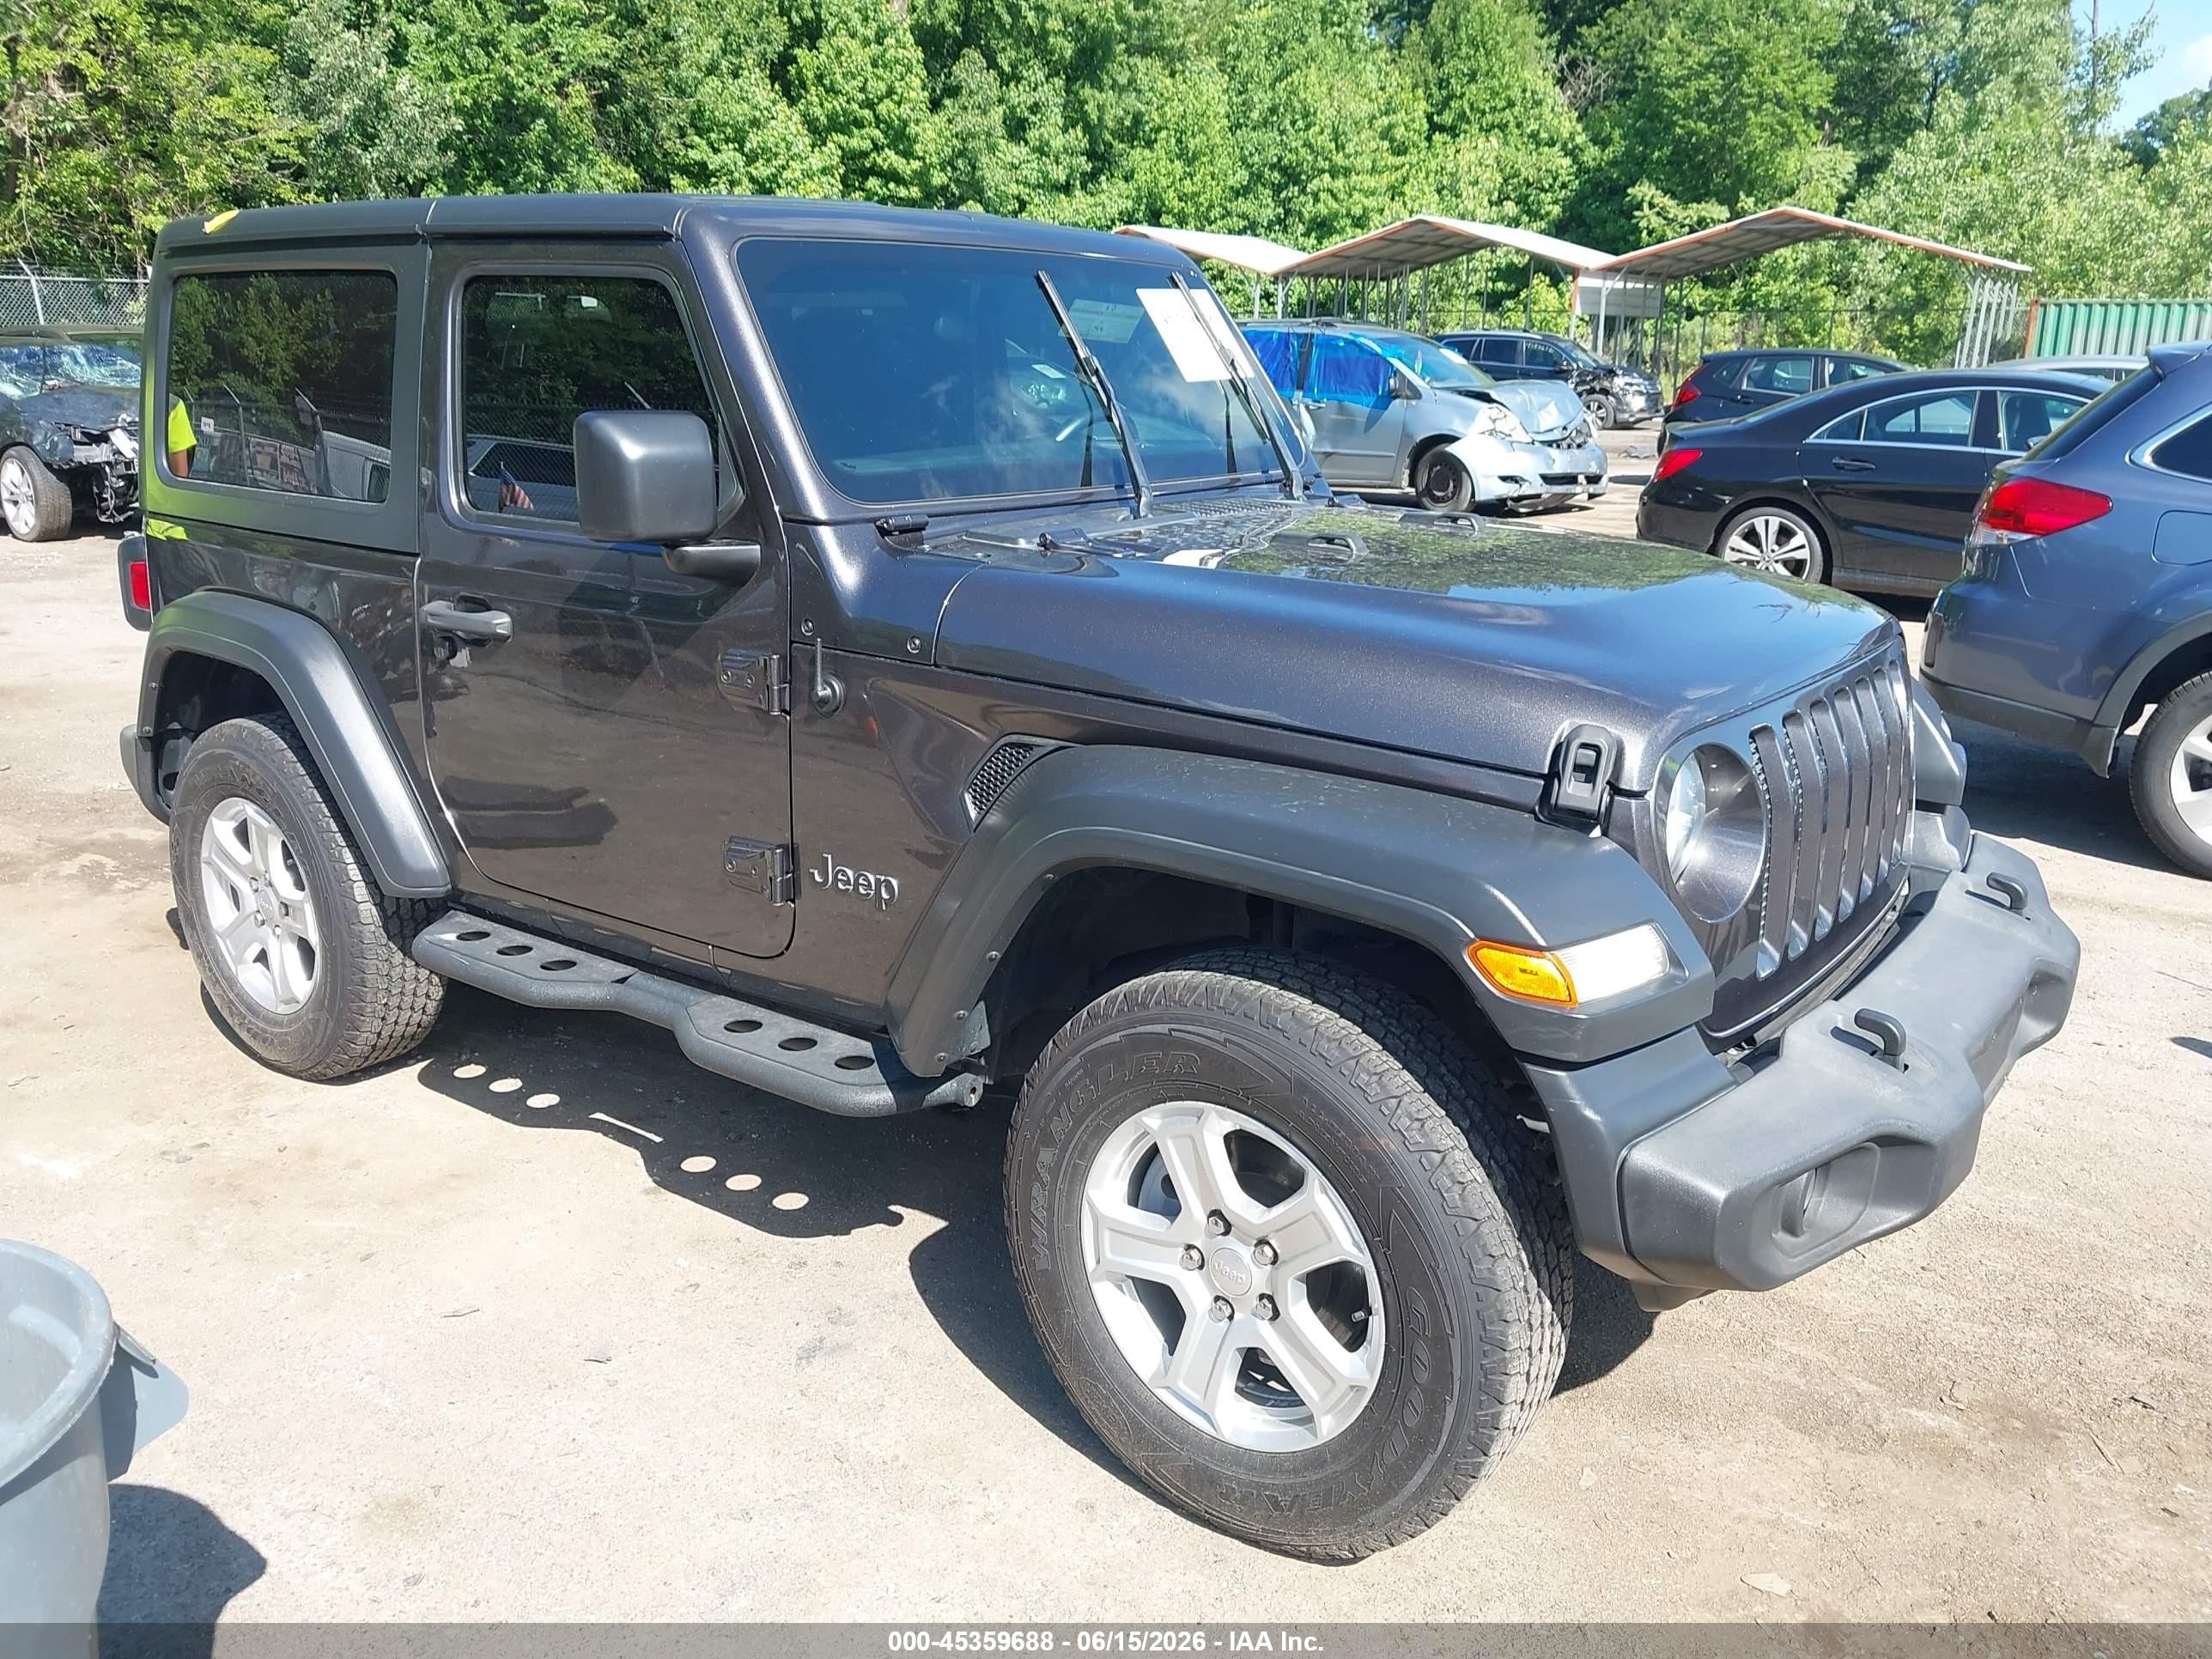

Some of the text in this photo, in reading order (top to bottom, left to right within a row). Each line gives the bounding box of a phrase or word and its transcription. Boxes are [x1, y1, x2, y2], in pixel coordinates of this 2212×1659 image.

[809, 853, 900, 911] Jeep
[1029, 1051, 1202, 1273] WRANGLER
[1213, 1259, 1247, 1285] Jeep
[1215, 1285, 1433, 1517] GOODYEAR
